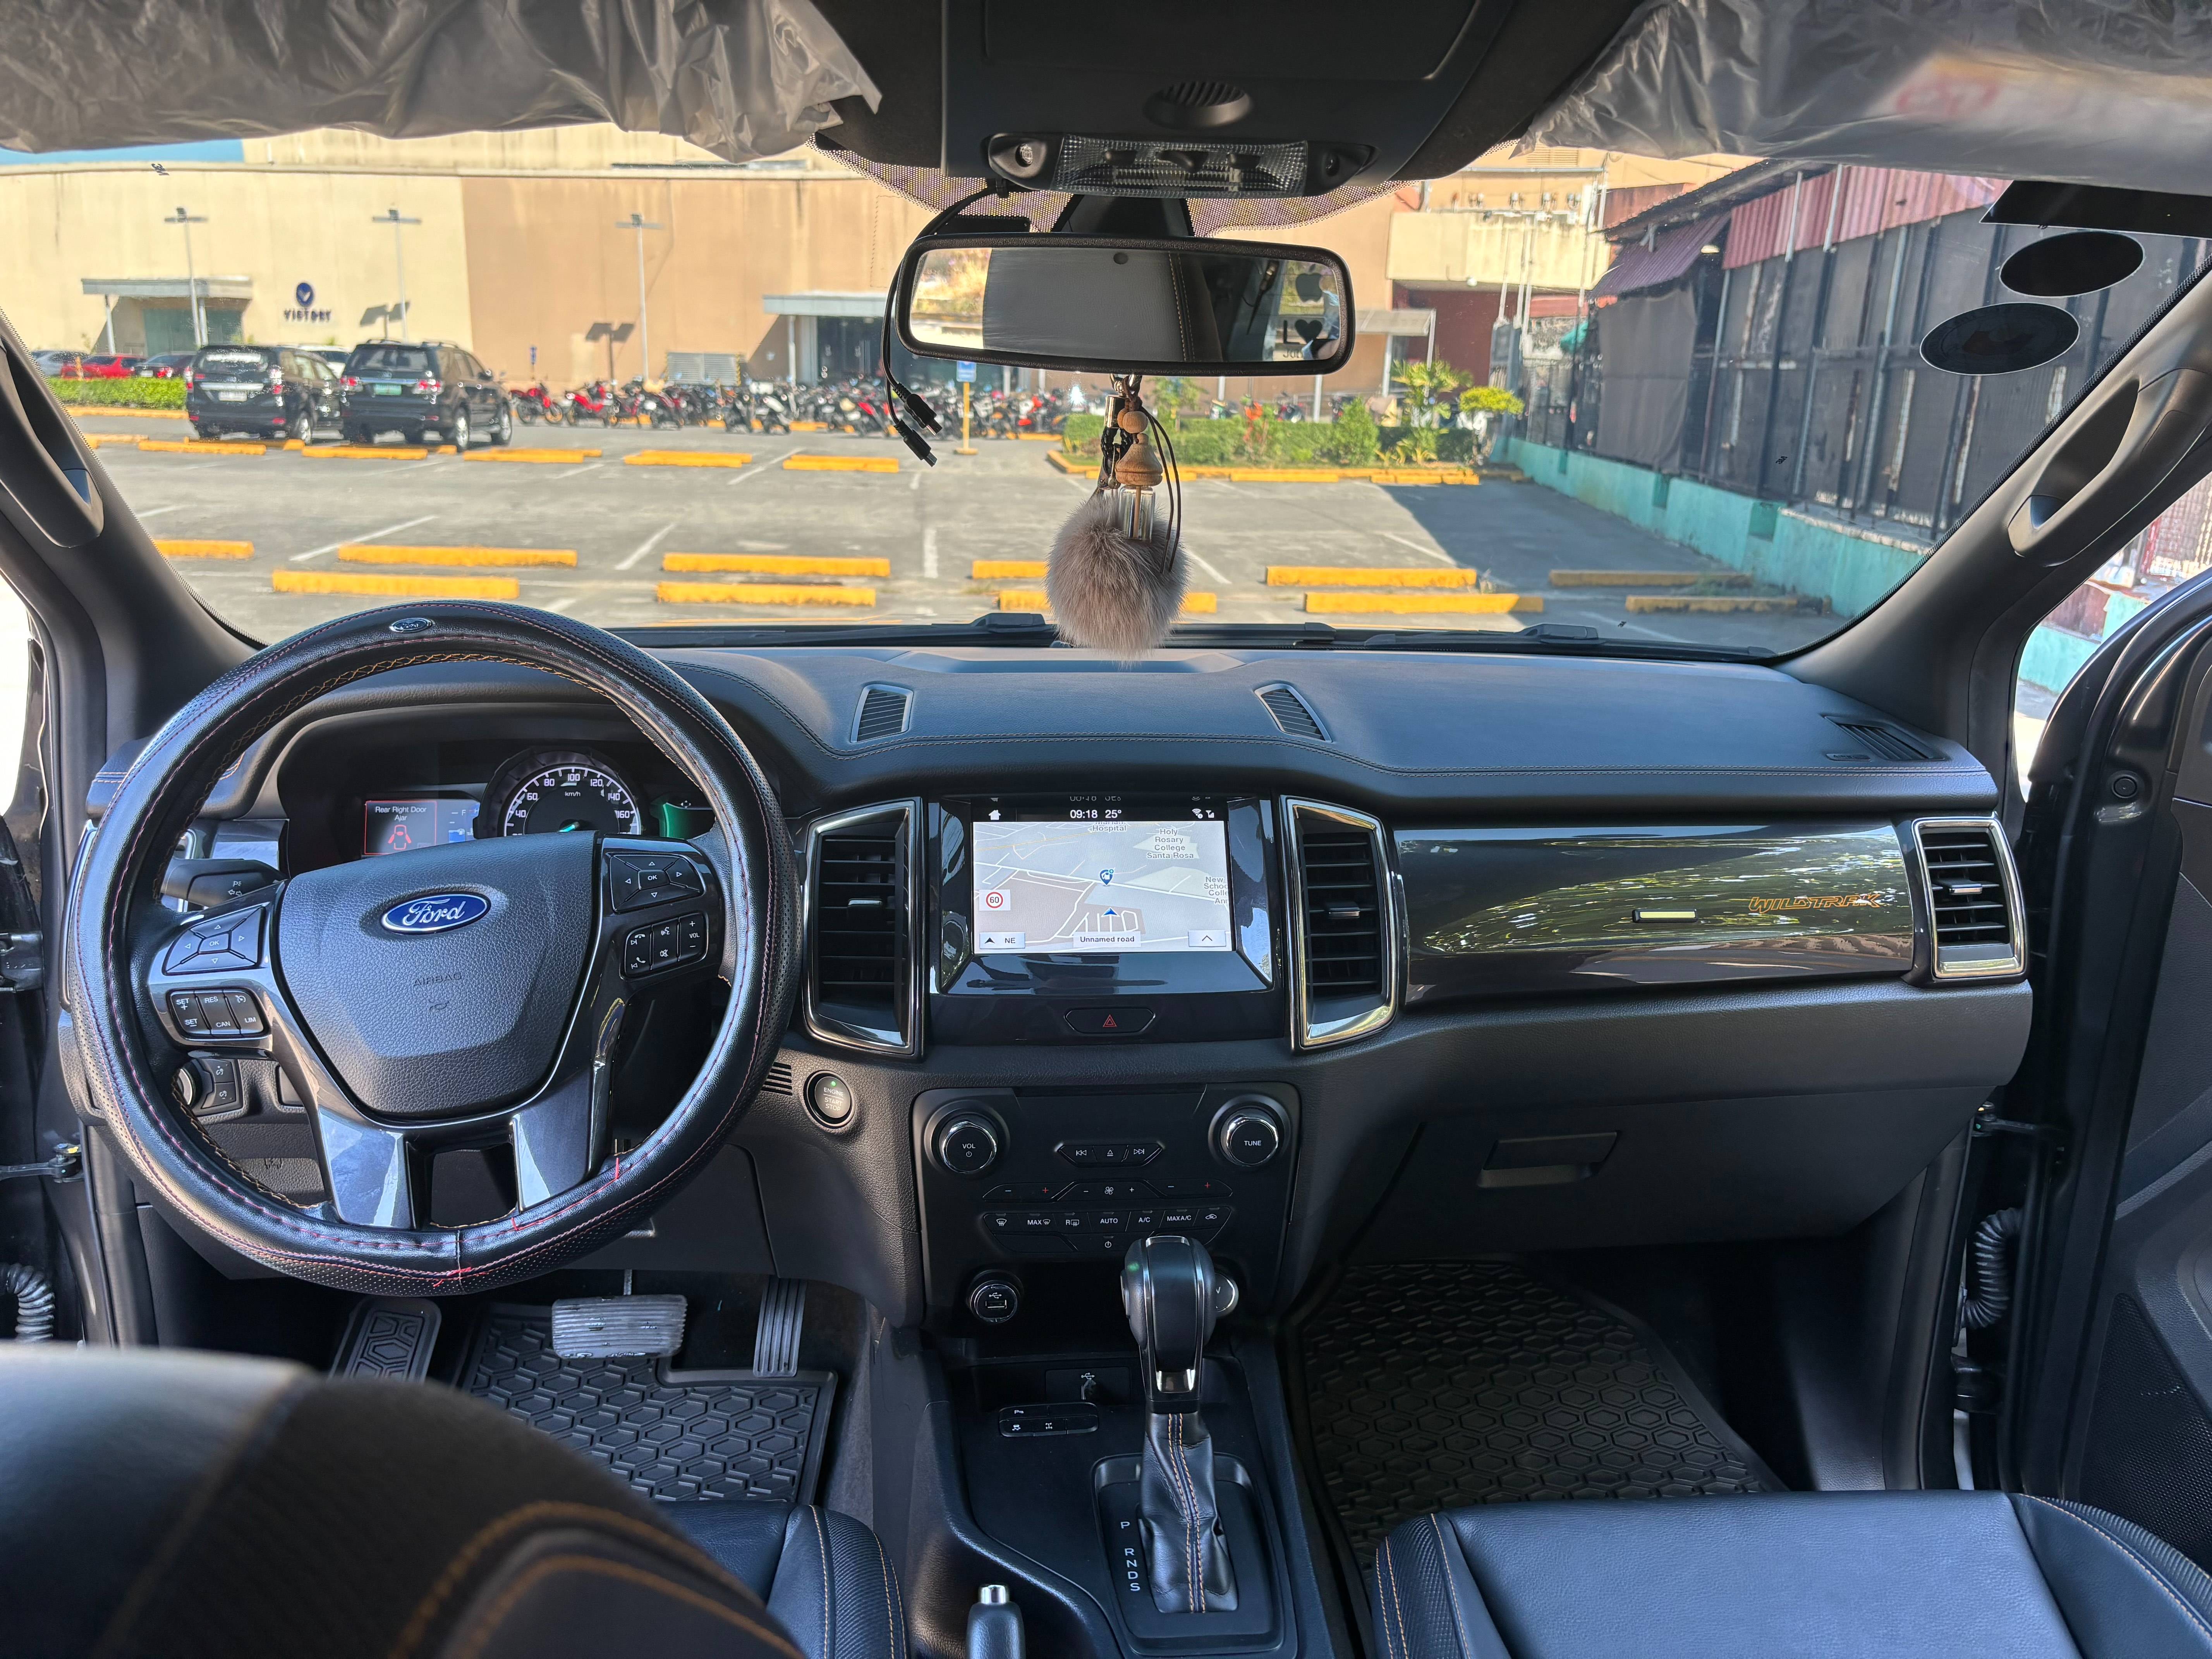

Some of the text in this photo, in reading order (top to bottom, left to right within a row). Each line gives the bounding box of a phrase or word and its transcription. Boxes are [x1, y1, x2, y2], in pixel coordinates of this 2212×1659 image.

[568, 773, 580, 781] 100
[544, 778, 555, 787] 80
[590, 779, 603, 787] 120
[527, 793, 538, 801] 60
[608, 793, 620, 801] 140
[617, 811, 630, 819] 160
[1070, 809, 1122, 819] 09:18 25°
[1748, 894, 1881, 914] WILDTRAK
[402, 898, 465, 926] Ford
[413, 974, 462, 987] AIRBAG
[824, 1087, 843, 1097] ENGINE
[824, 1097, 843, 1106] START
[1121, 1521, 1130, 1529] P
[1127, 1560, 1137, 1568] N
[1128, 1571, 1138, 1580] D
[1130, 1583, 1140, 1591] S
